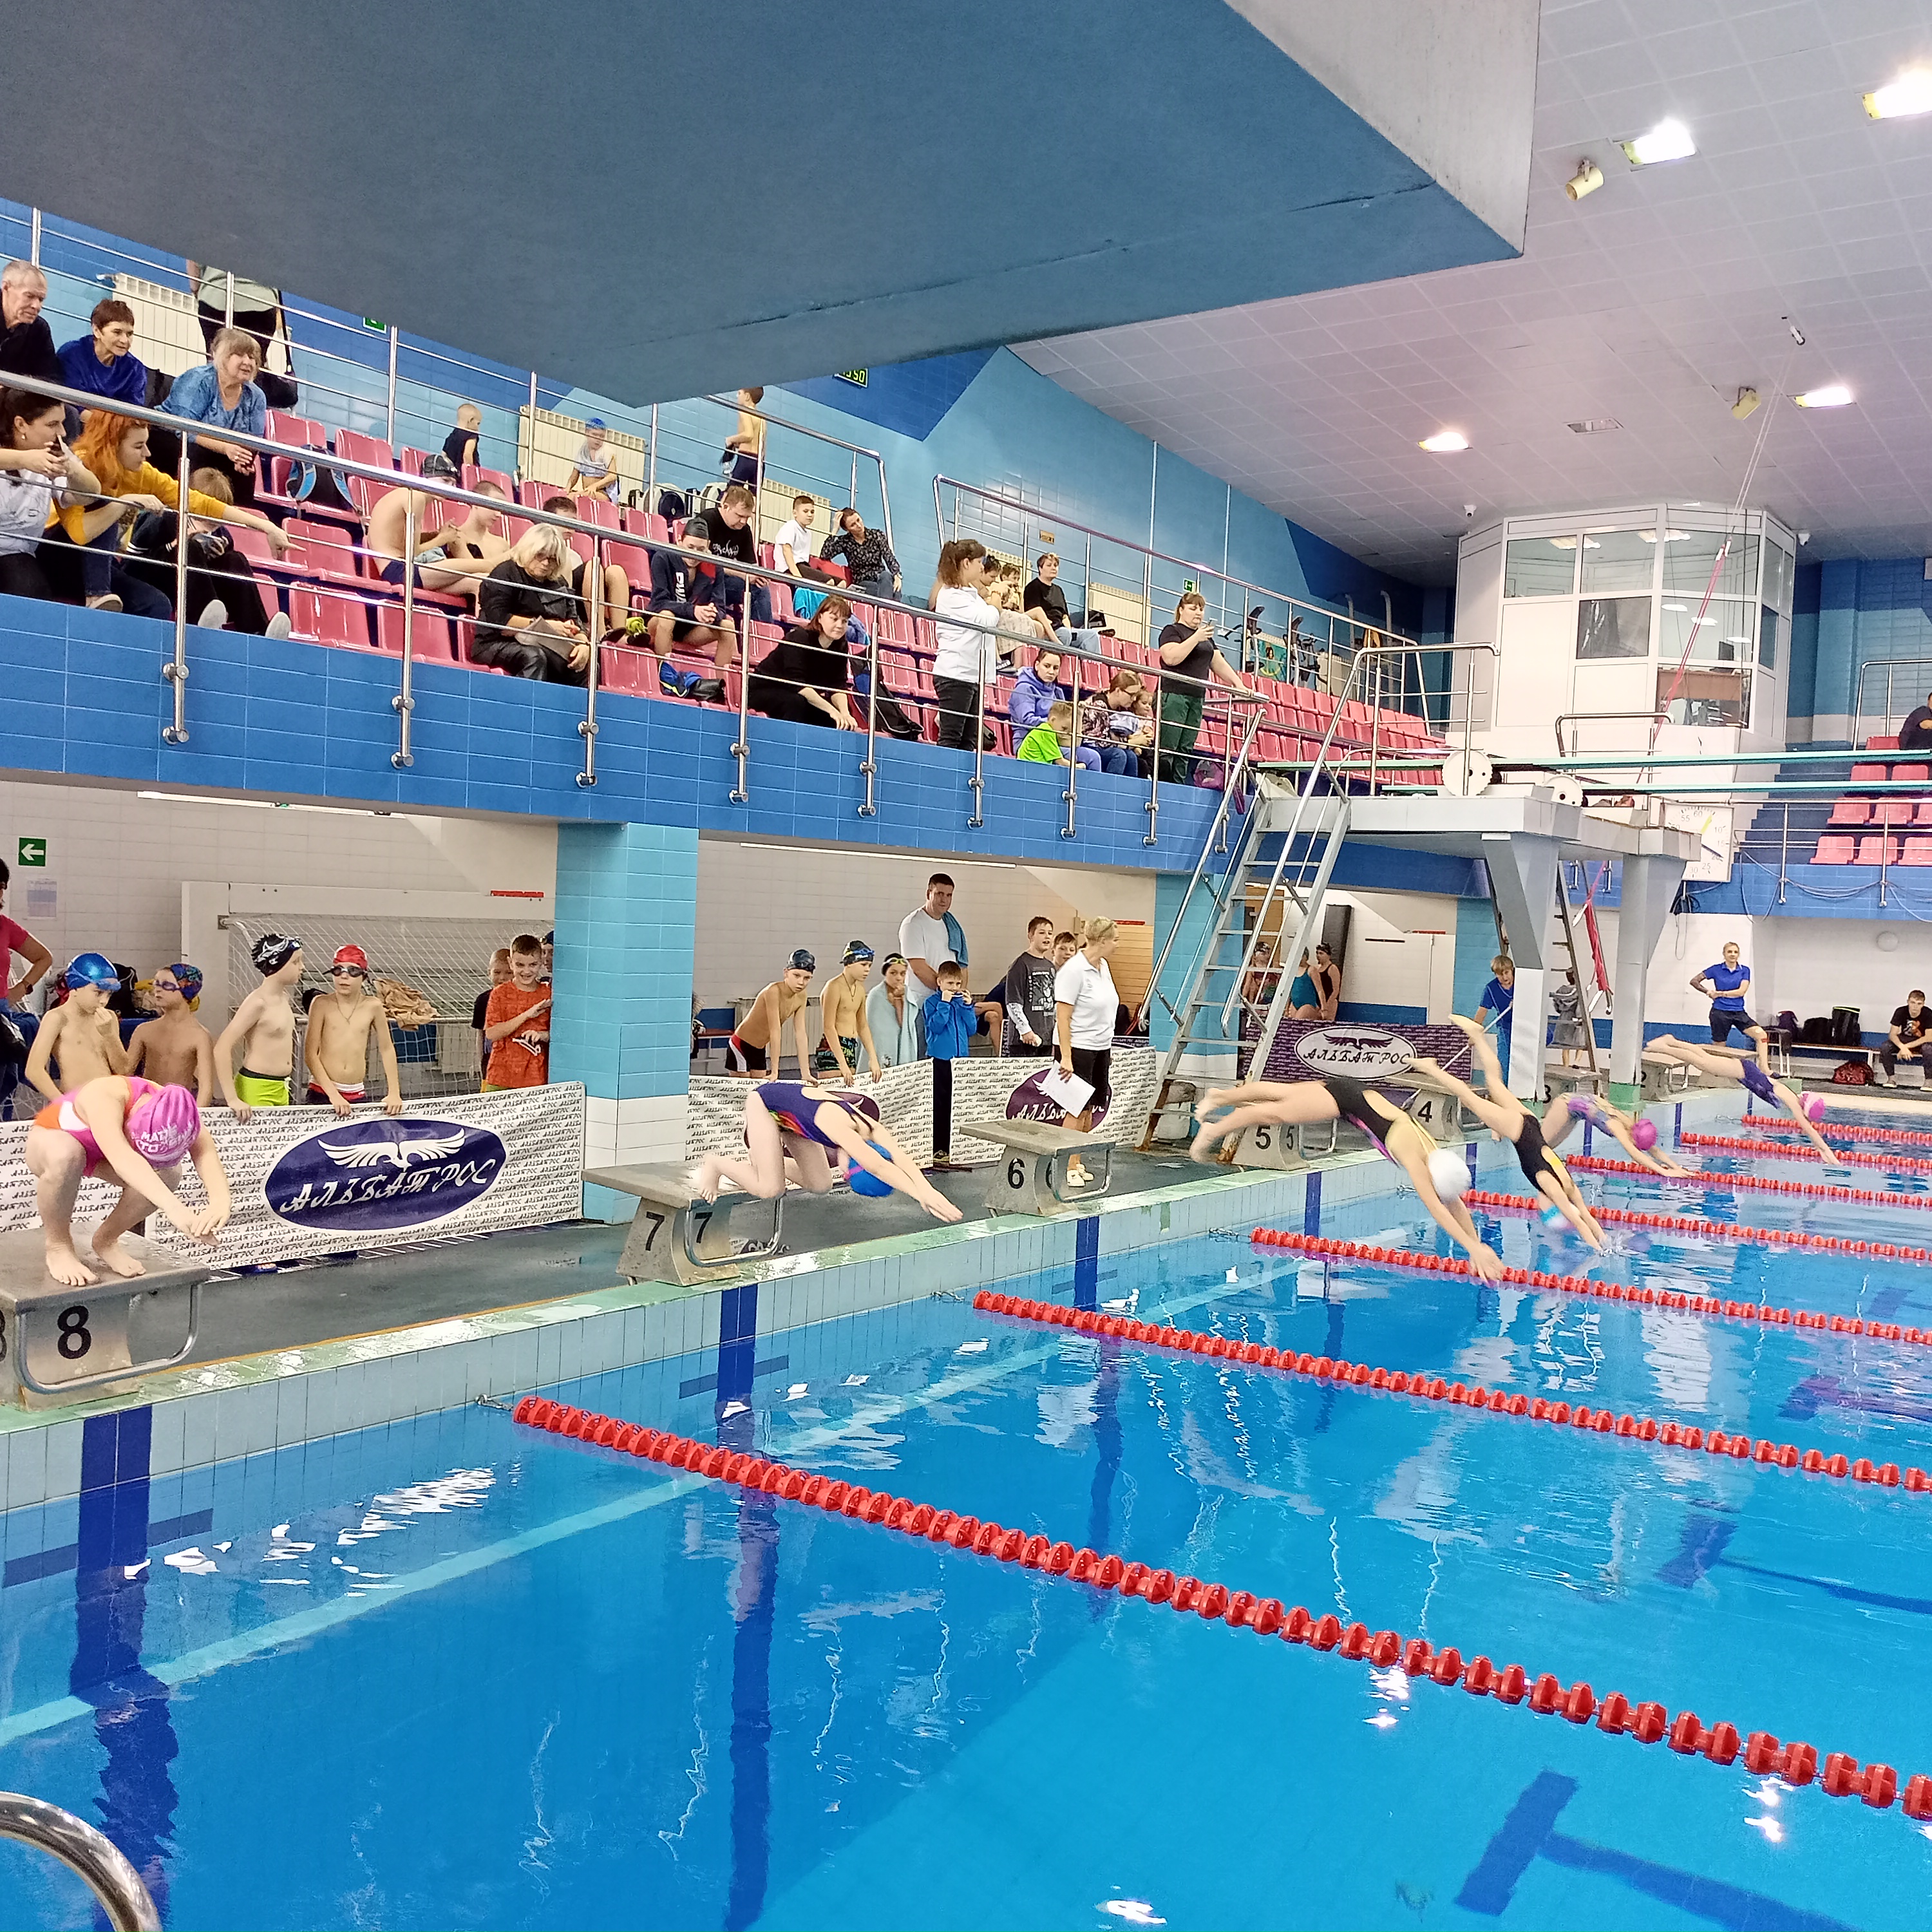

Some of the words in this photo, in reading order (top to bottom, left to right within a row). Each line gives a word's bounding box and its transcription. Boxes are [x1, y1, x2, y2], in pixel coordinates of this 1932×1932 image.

[1303, 1048, 1410, 1065] АЛЬБАТРОС
[1418, 1101, 1432, 1122] 4
[1256, 1124, 1271, 1150] 5
[1286, 1125, 1294, 1150] 5
[279, 1159, 495, 1213] АЛЬБАТРОС
[1007, 1158, 1025, 1189] 6
[646, 1211, 665, 1251] 7
[694, 1212, 713, 1244] 7
[57, 1305, 91, 1359] 8
